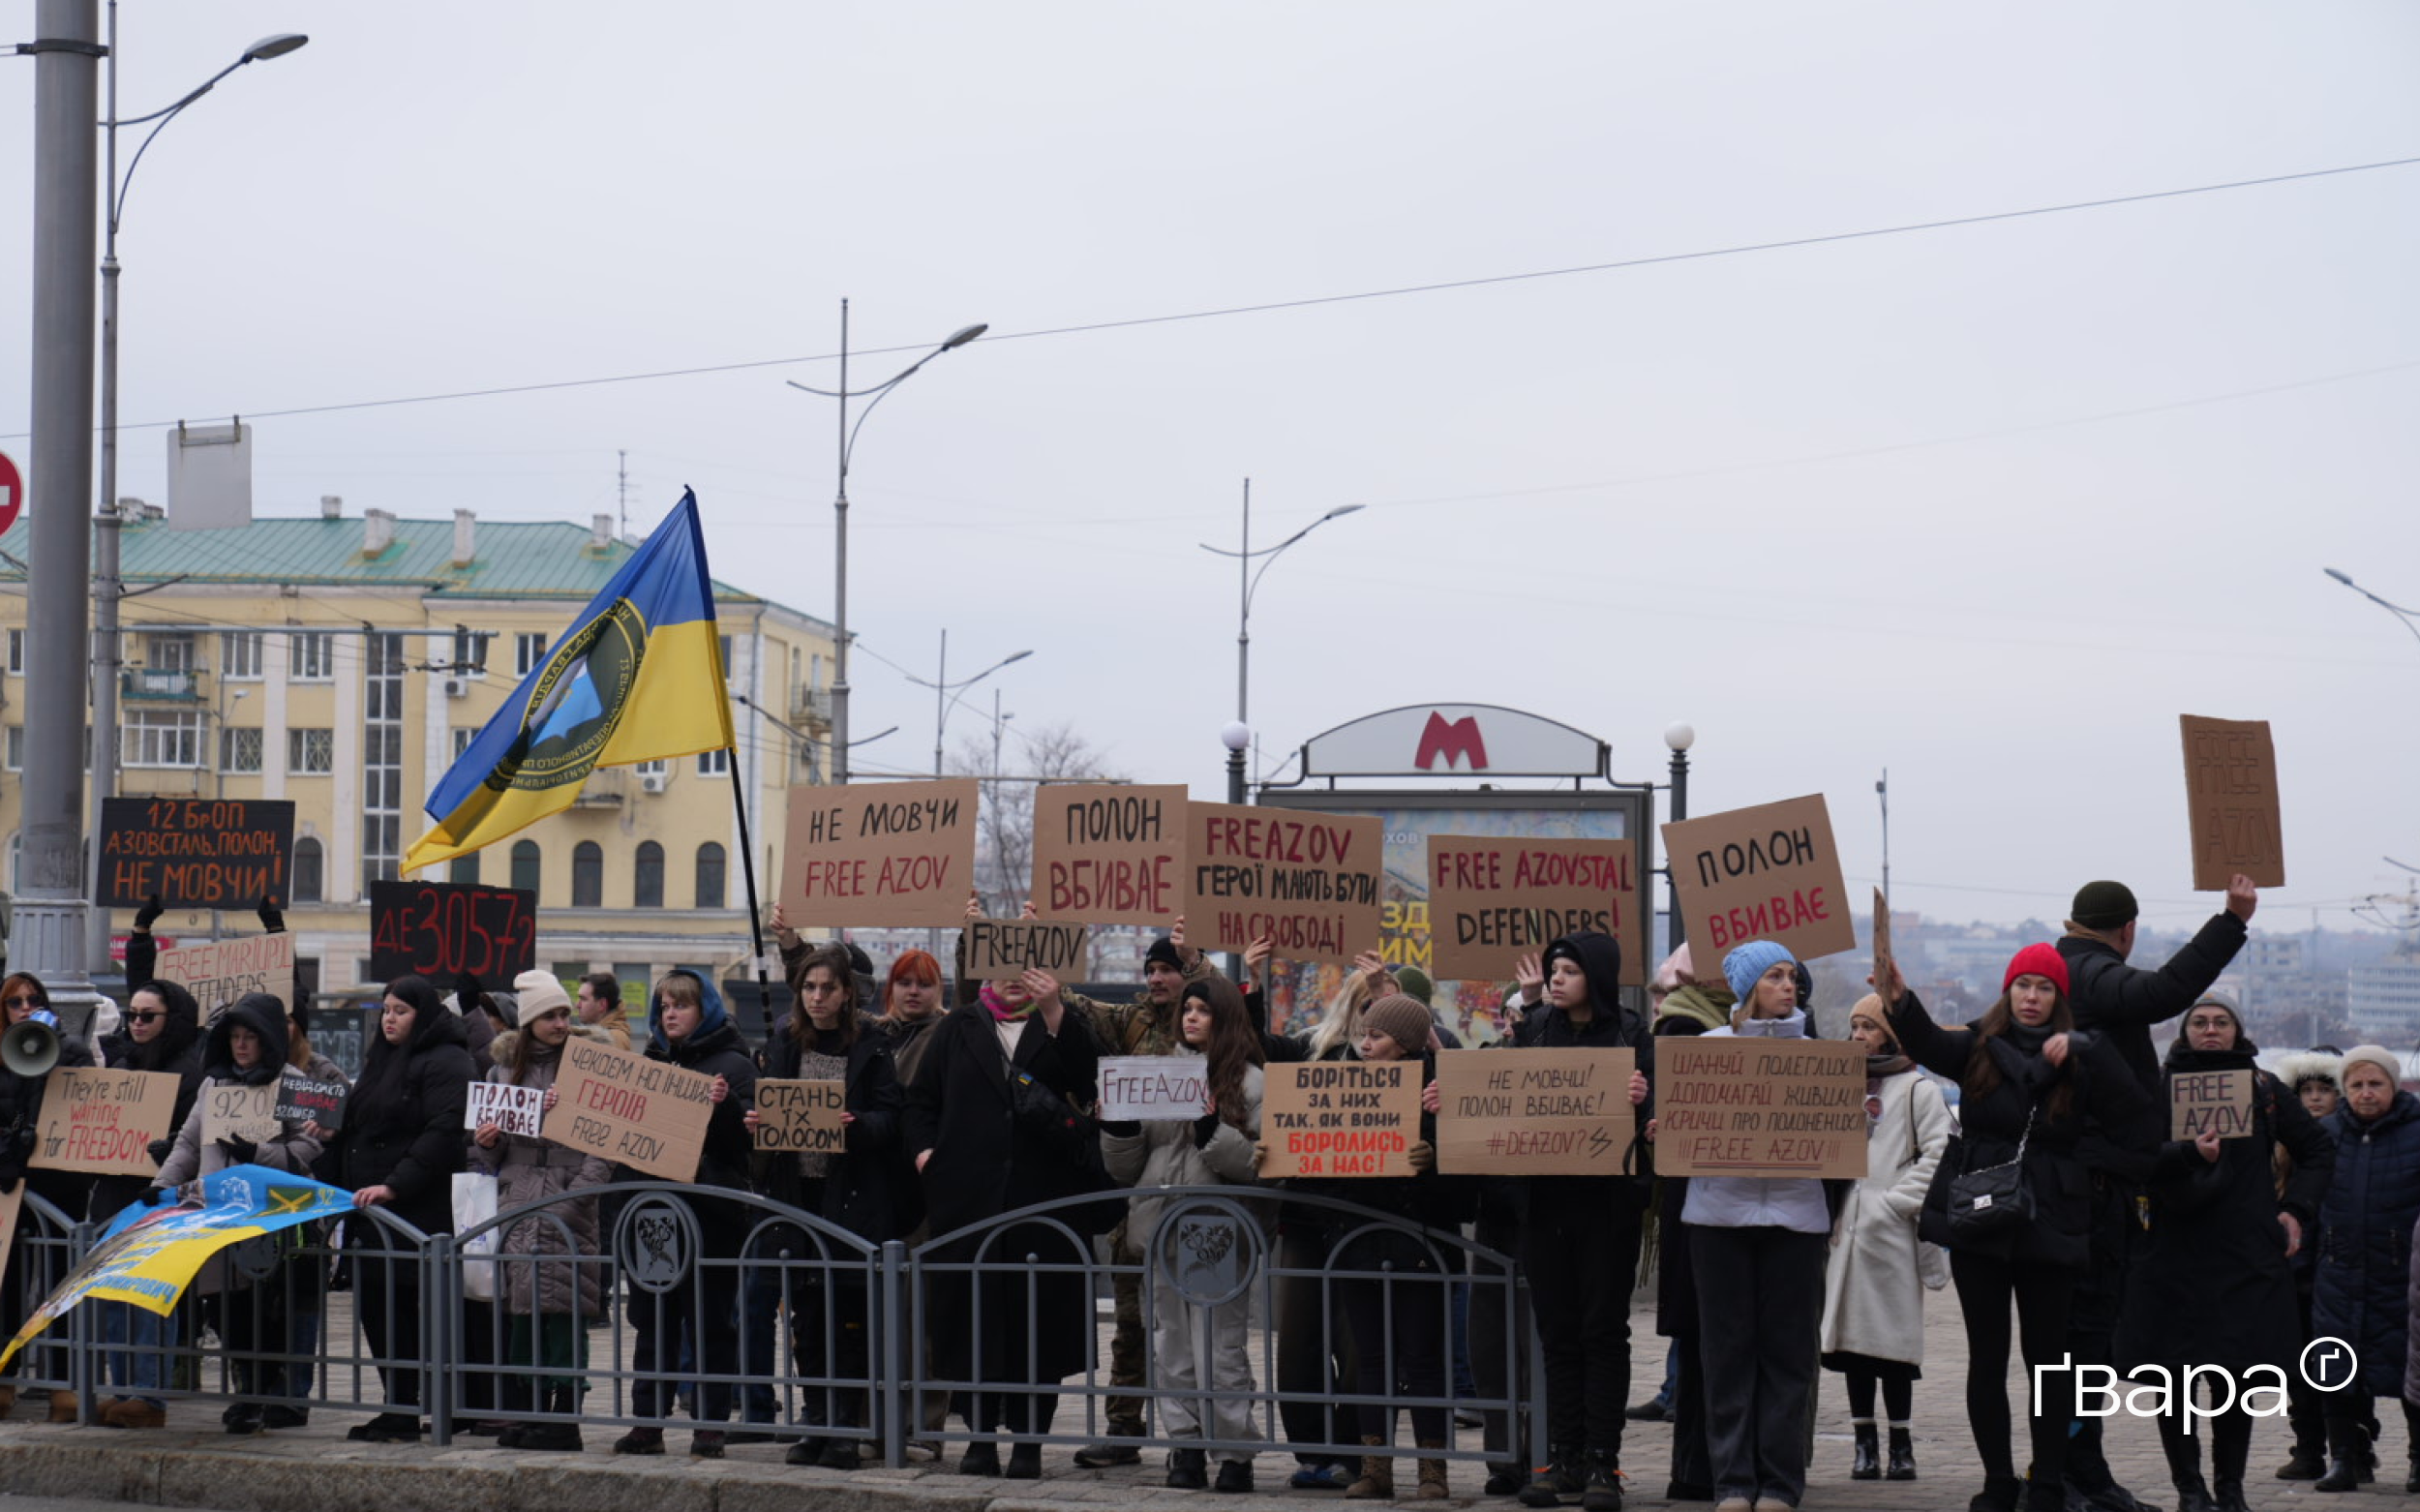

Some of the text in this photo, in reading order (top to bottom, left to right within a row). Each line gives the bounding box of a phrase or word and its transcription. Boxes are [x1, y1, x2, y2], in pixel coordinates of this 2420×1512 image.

[2193, 730, 2261, 795] FREE
[147, 801, 177, 830] 12
[809, 799, 959, 844] НЕ МОВЧИ
[1067, 796, 1162, 845] ПОЛОН
[1206, 817, 1351, 865] FREAZOV
[2202, 806, 2282, 865] AZOV
[1437, 850, 1634, 892] FREE AZOVSTAL
[1697, 826, 1815, 888] ПОЛОН
[113, 856, 282, 904] НЕ МОВЧИ!
[805, 855, 950, 898] FREE AZOV
[1196, 863, 1377, 906] ГЕРОЇ МАЮТЬ БУТИ
[373, 907, 415, 953] ДЕ
[1709, 887, 1830, 949] ВБИВАЄ
[163, 947, 215, 981] FREE
[189, 972, 267, 1011] EFENDERS
[1489, 1063, 1594, 1090] НЕ МОВЧИ!
[1672, 1051, 1744, 1075] ШАНУЙ
[115, 1074, 147, 1103] still
[213, 1089, 247, 1118] 92
[472, 1084, 538, 1112] ПОЛОН
[577, 1078, 649, 1124] ГЕРОЇВ
[759, 1085, 842, 1109] СТАНЬ
[1309, 1093, 1381, 1108] ЗА НИХ
[1458, 1092, 1605, 1117] ПОЛОН ВБИВАЄ!
[1665, 1080, 1772, 1105] ДОПОМАГАЙ
[2174, 1073, 2233, 1104] FREE
[782, 1107, 810, 1126] ЇХ
[1318, 1113, 1344, 1127] ЯК
[1350, 1112, 1401, 1127] ВОНИ
[1664, 1110, 1723, 1131] КРИЧИ
[1731, 1112, 1761, 1131] ПРО
[2183, 1104, 2253, 1136] AZOV
[44, 1121, 150, 1164] for FREEDOM
[618, 1131, 666, 1163] AZOV
[756, 1123, 842, 1149] ГОЛОСОМ
[1288, 1131, 1407, 1154] БОРОЛИСЬ
[1299, 1153, 1384, 1174] ЗА НАС!
